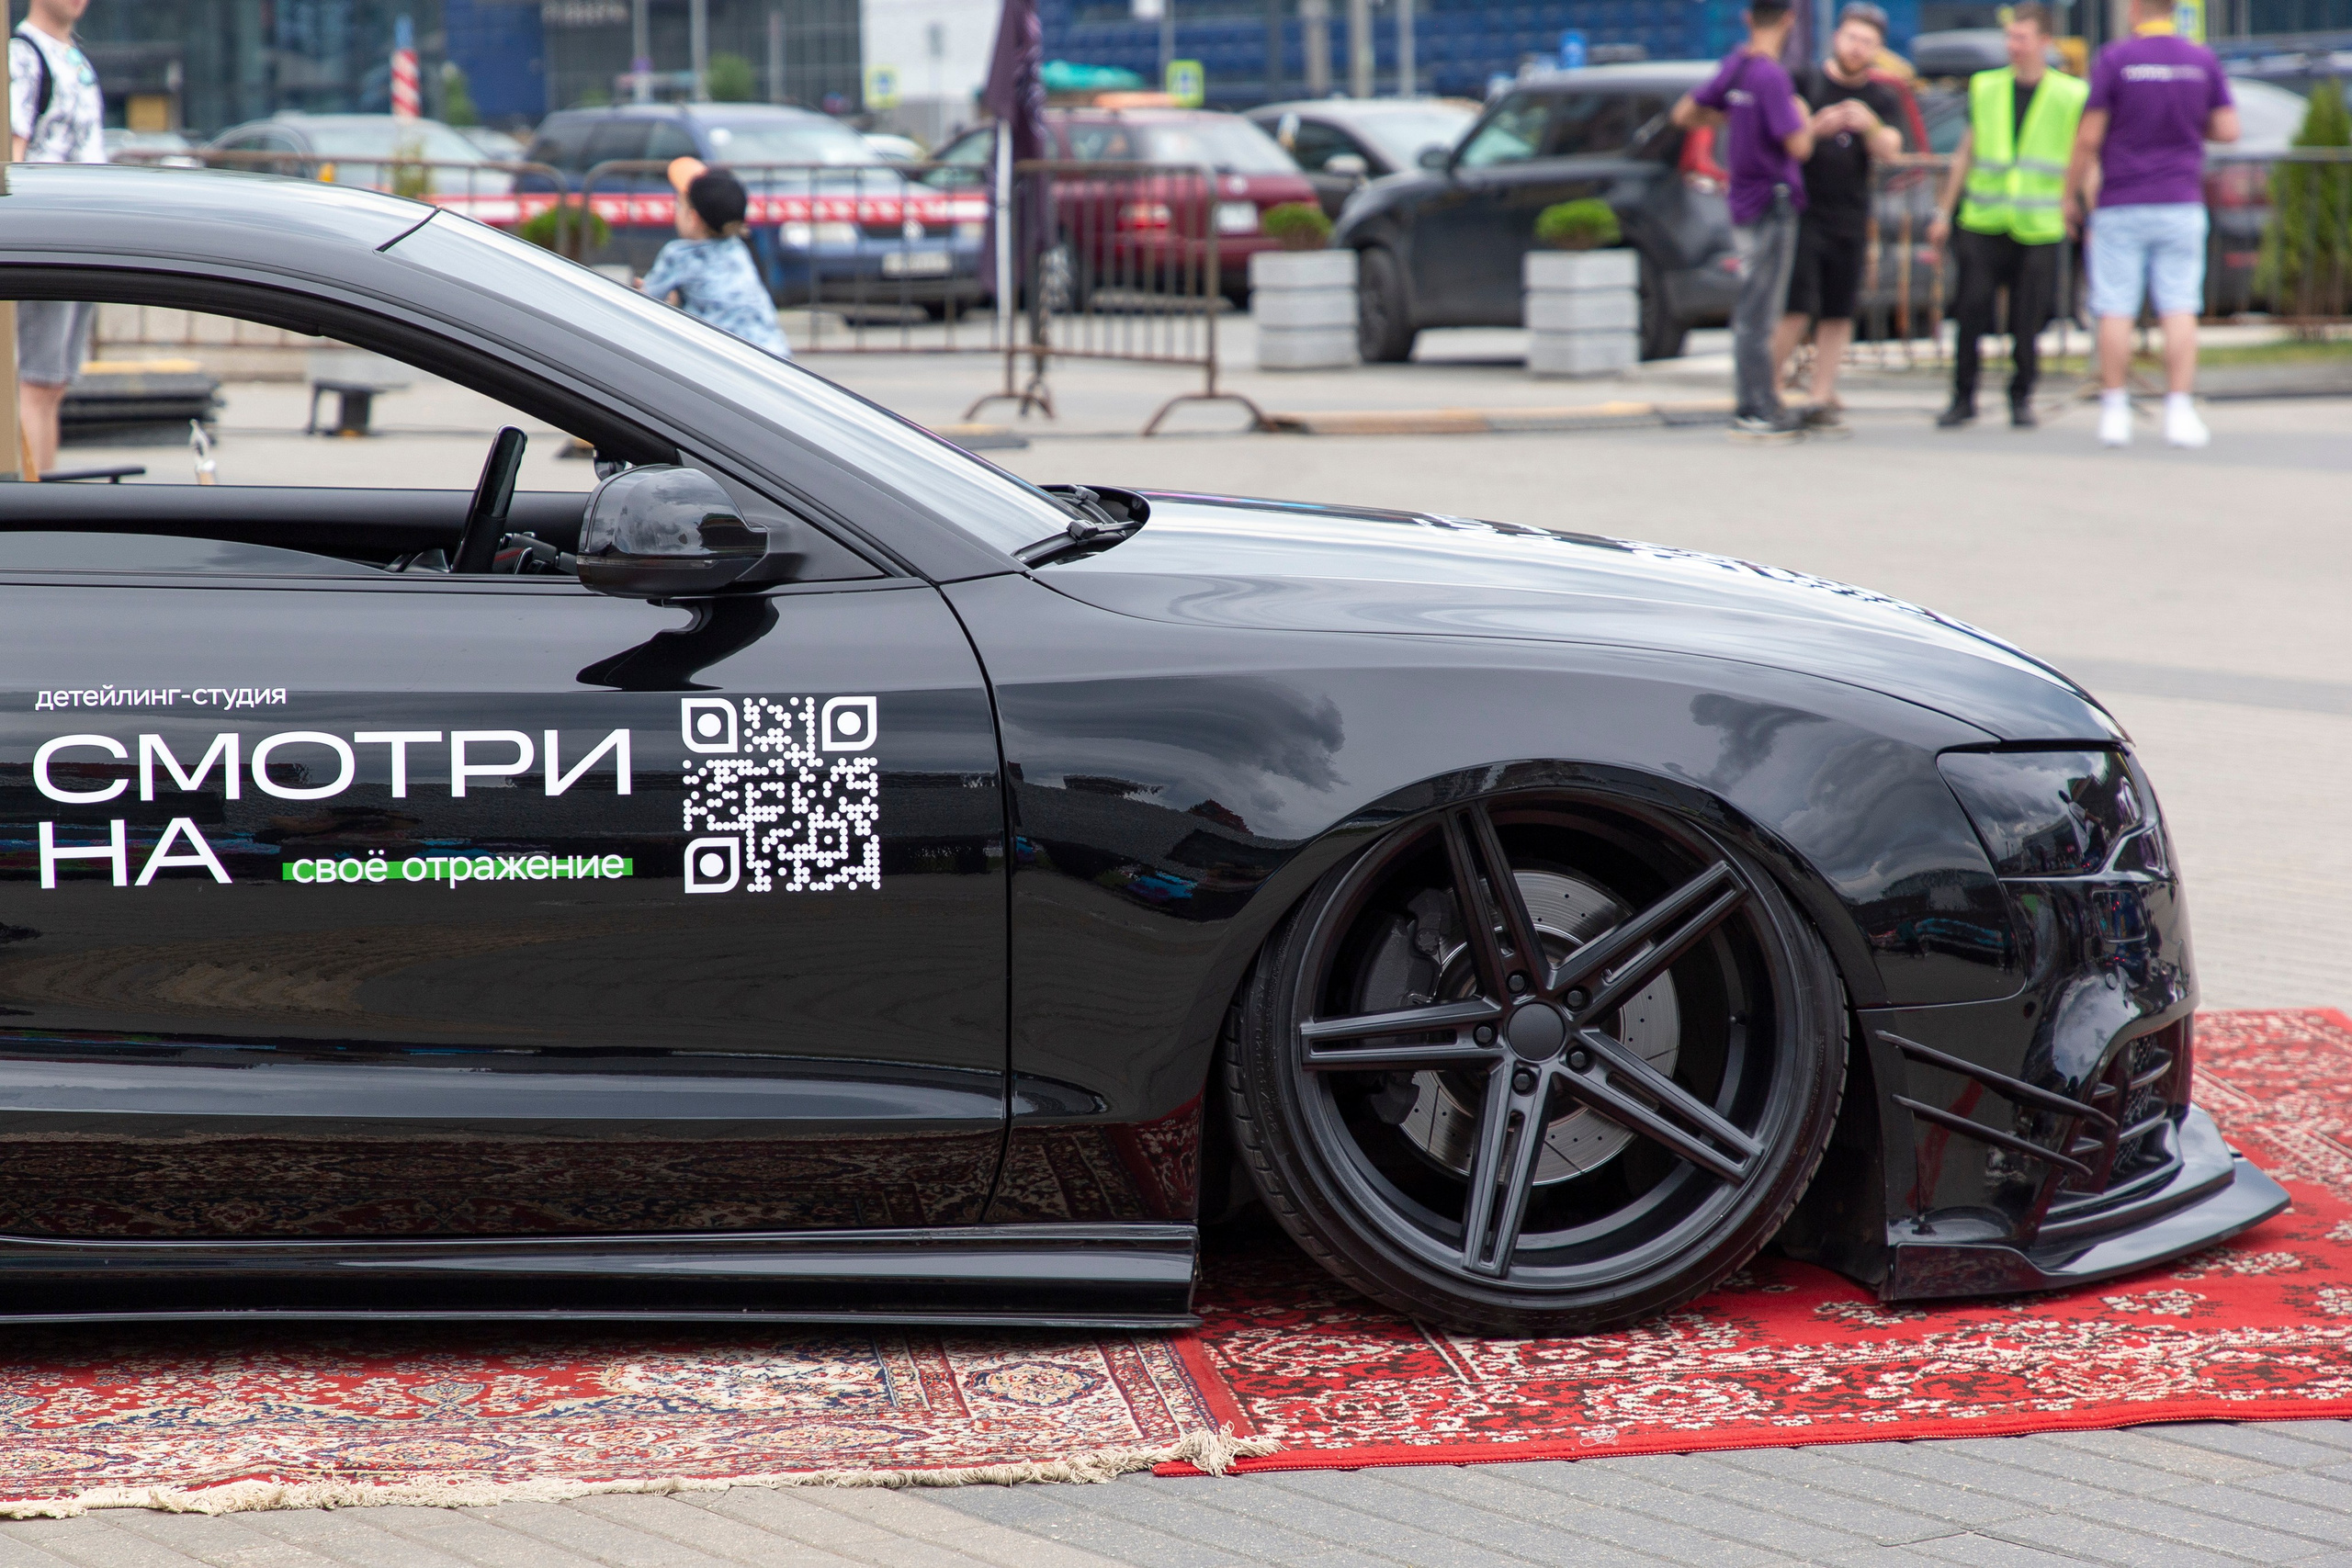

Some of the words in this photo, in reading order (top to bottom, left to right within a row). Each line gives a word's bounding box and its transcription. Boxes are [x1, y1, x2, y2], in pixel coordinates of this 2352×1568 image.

[35, 684, 287, 710] детейлинг-студия
[33, 728, 631, 804] СМОТРИ
[39, 817, 232, 889] НА
[292, 849, 388, 883] своё
[401, 854, 625, 889] отражение
